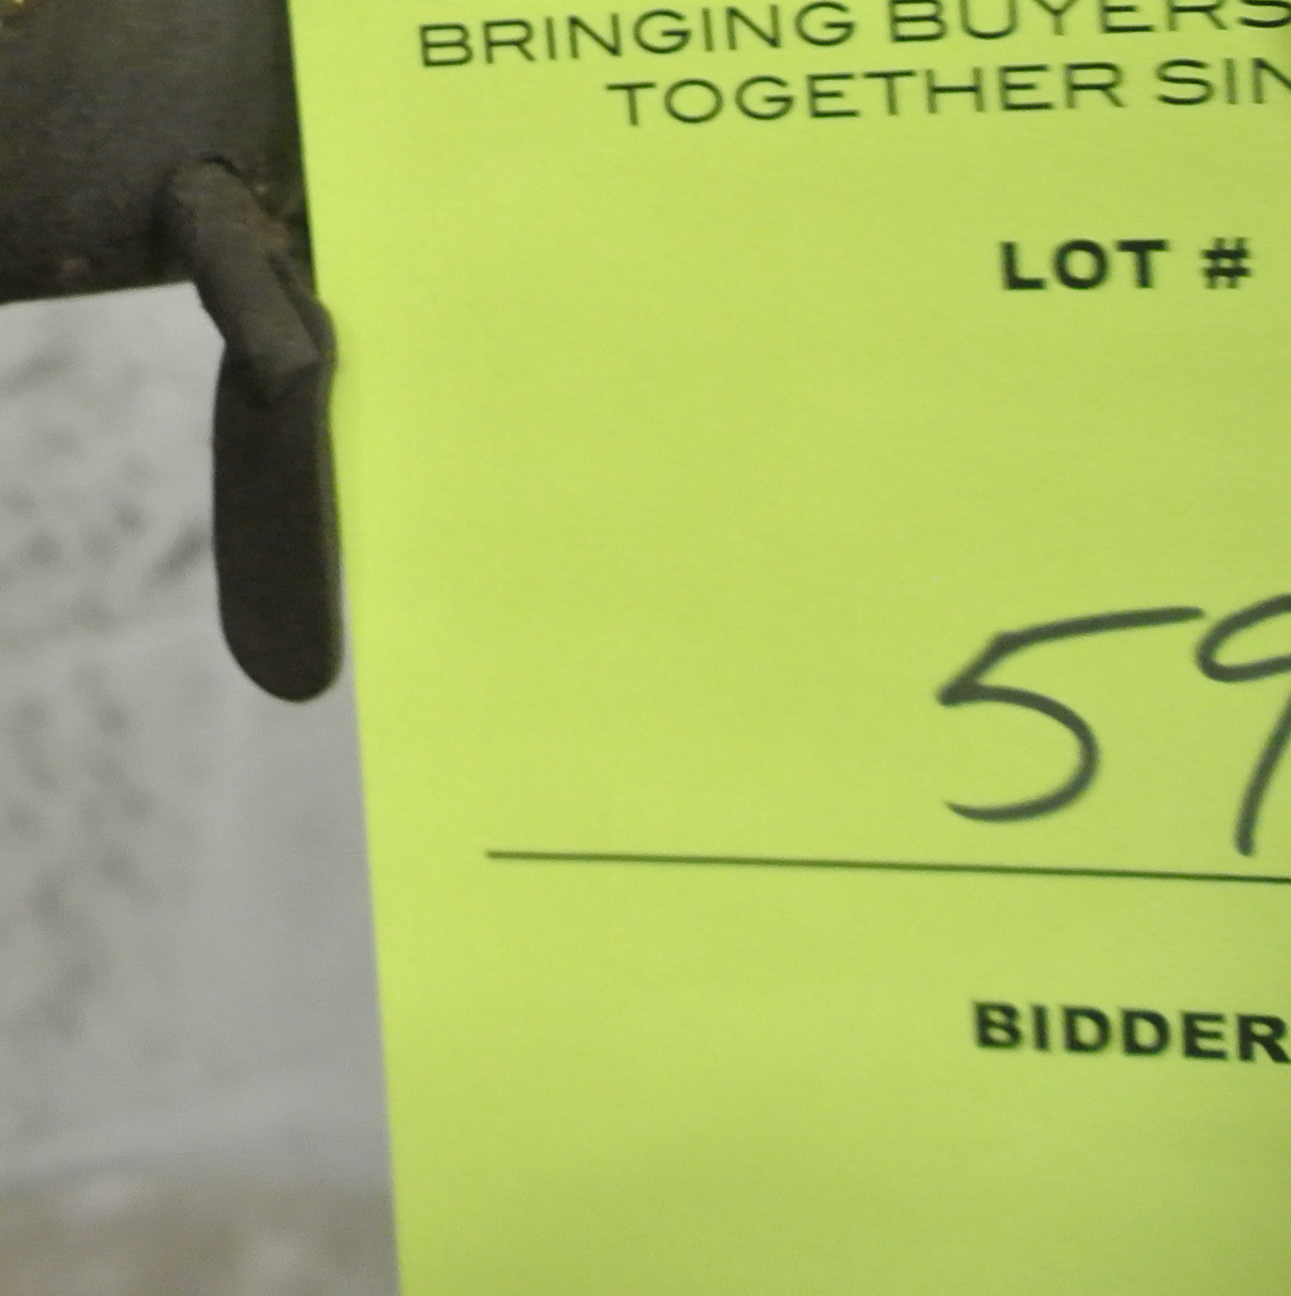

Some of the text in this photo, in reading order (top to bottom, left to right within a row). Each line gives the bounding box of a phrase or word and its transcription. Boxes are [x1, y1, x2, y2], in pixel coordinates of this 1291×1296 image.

[420, 0, 858, 68] BRINGING
[605, 61, 1125, 126] TOGETHER
[1000, 239, 1252, 291] LOT #
[937, 592, 1291, 858] 59
[974, 1001, 1291, 1064] BIDDER
